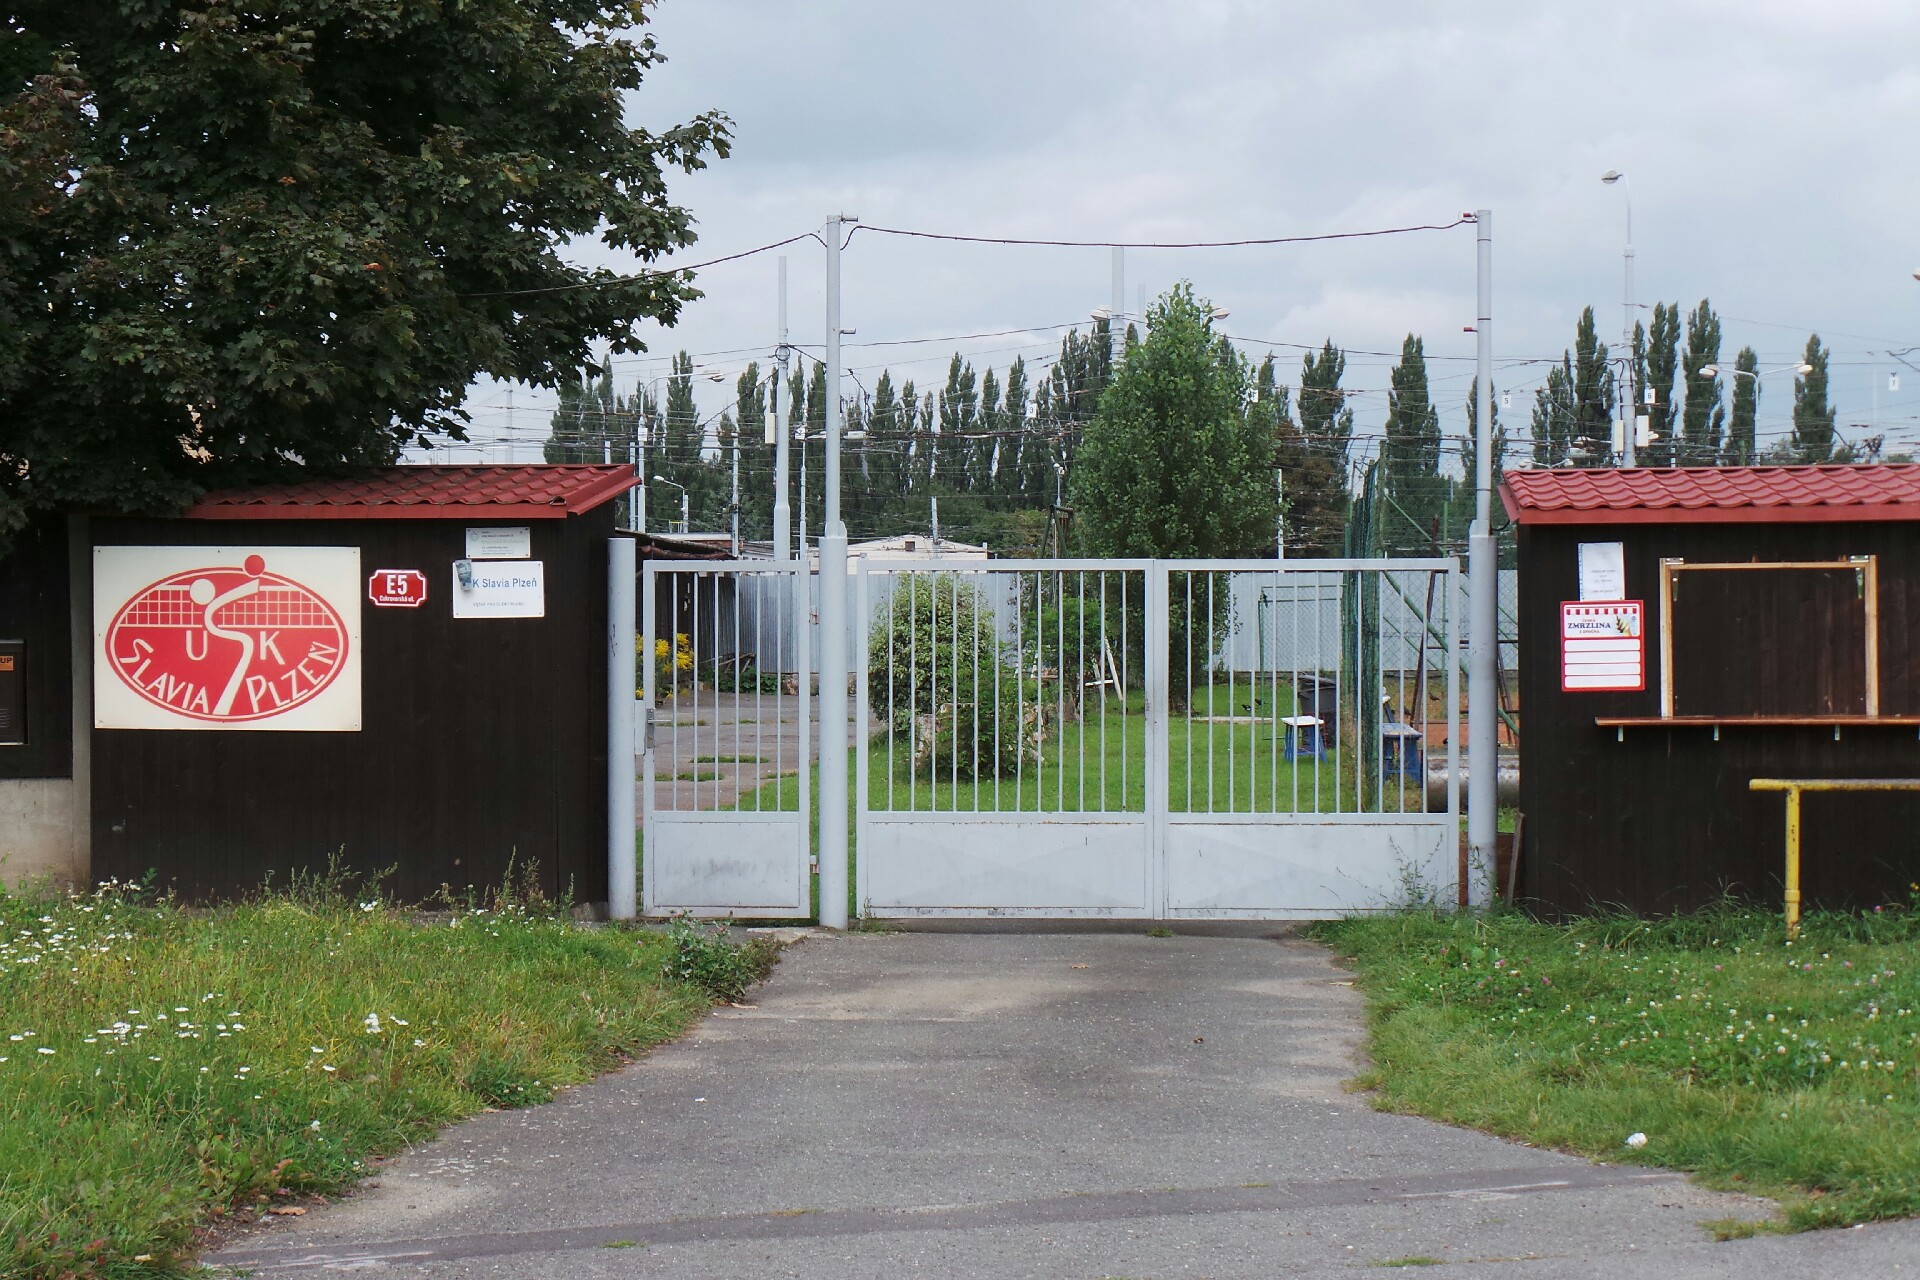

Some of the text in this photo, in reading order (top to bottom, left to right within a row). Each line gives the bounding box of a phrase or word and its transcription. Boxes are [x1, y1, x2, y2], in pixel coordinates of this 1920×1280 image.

[386, 574, 407, 595] E5
[483, 578, 510, 588] Slavia
[513, 577, 537, 588] Plzeň
[119, 639, 338, 714] SLAVIA PLZEŇ
